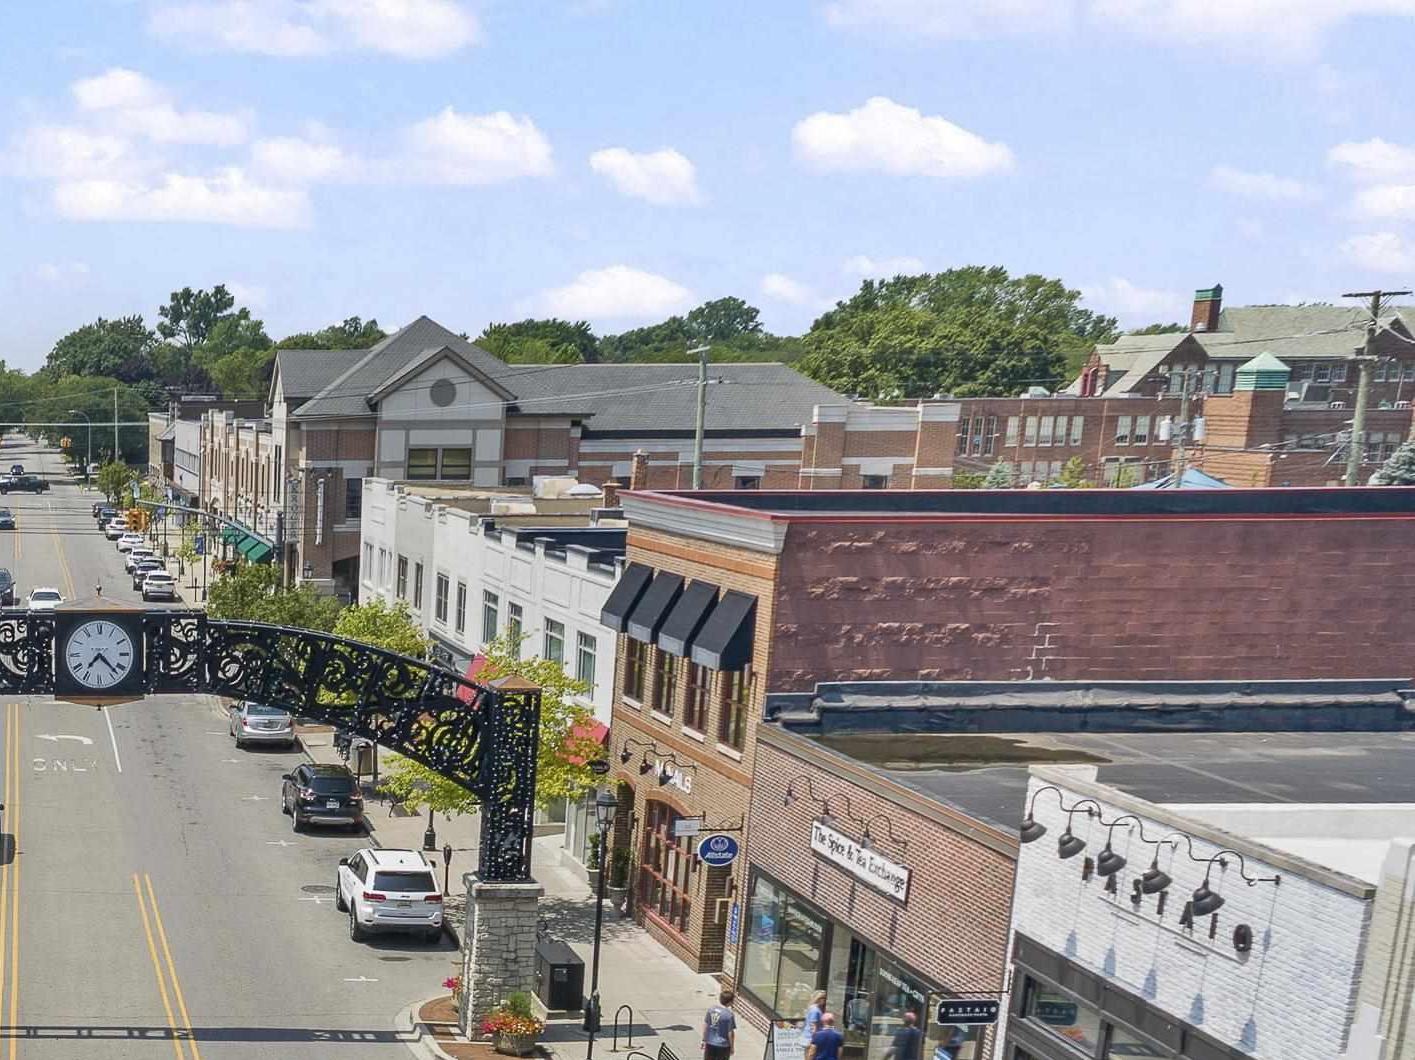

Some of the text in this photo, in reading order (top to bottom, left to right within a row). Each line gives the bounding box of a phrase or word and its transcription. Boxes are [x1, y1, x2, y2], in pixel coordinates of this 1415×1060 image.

[814, 825, 906, 894] The Spice & Tea Exchange
